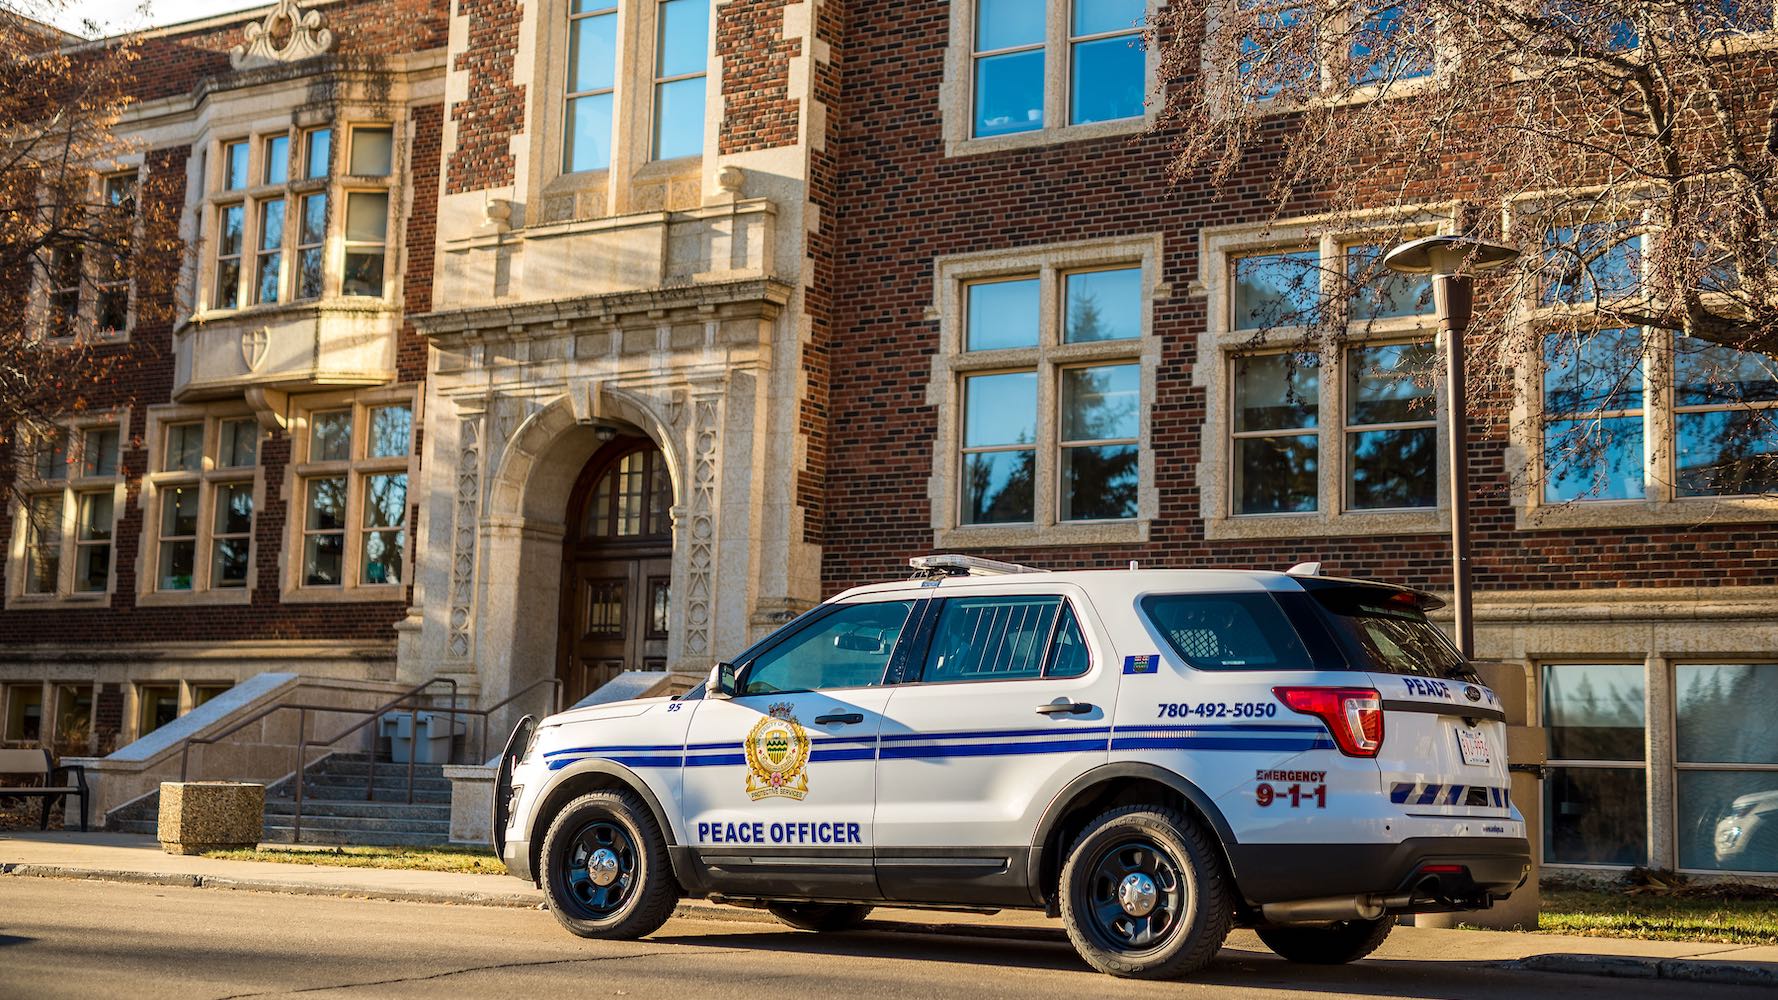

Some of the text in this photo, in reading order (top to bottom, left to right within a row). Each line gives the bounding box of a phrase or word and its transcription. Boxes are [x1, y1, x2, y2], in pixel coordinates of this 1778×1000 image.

[1402, 677, 1452, 699] PEACE
[667, 703, 682, 712] 95
[1157, 702, 1277, 718] 780-492-5050
[1256, 769, 1327, 782] EMERGENCY
[751, 787, 803, 798] PROTECTIVE SERVICES
[1256, 783, 1327, 809] 9-1-1
[698, 822, 861, 843] PEACE OFFICER
